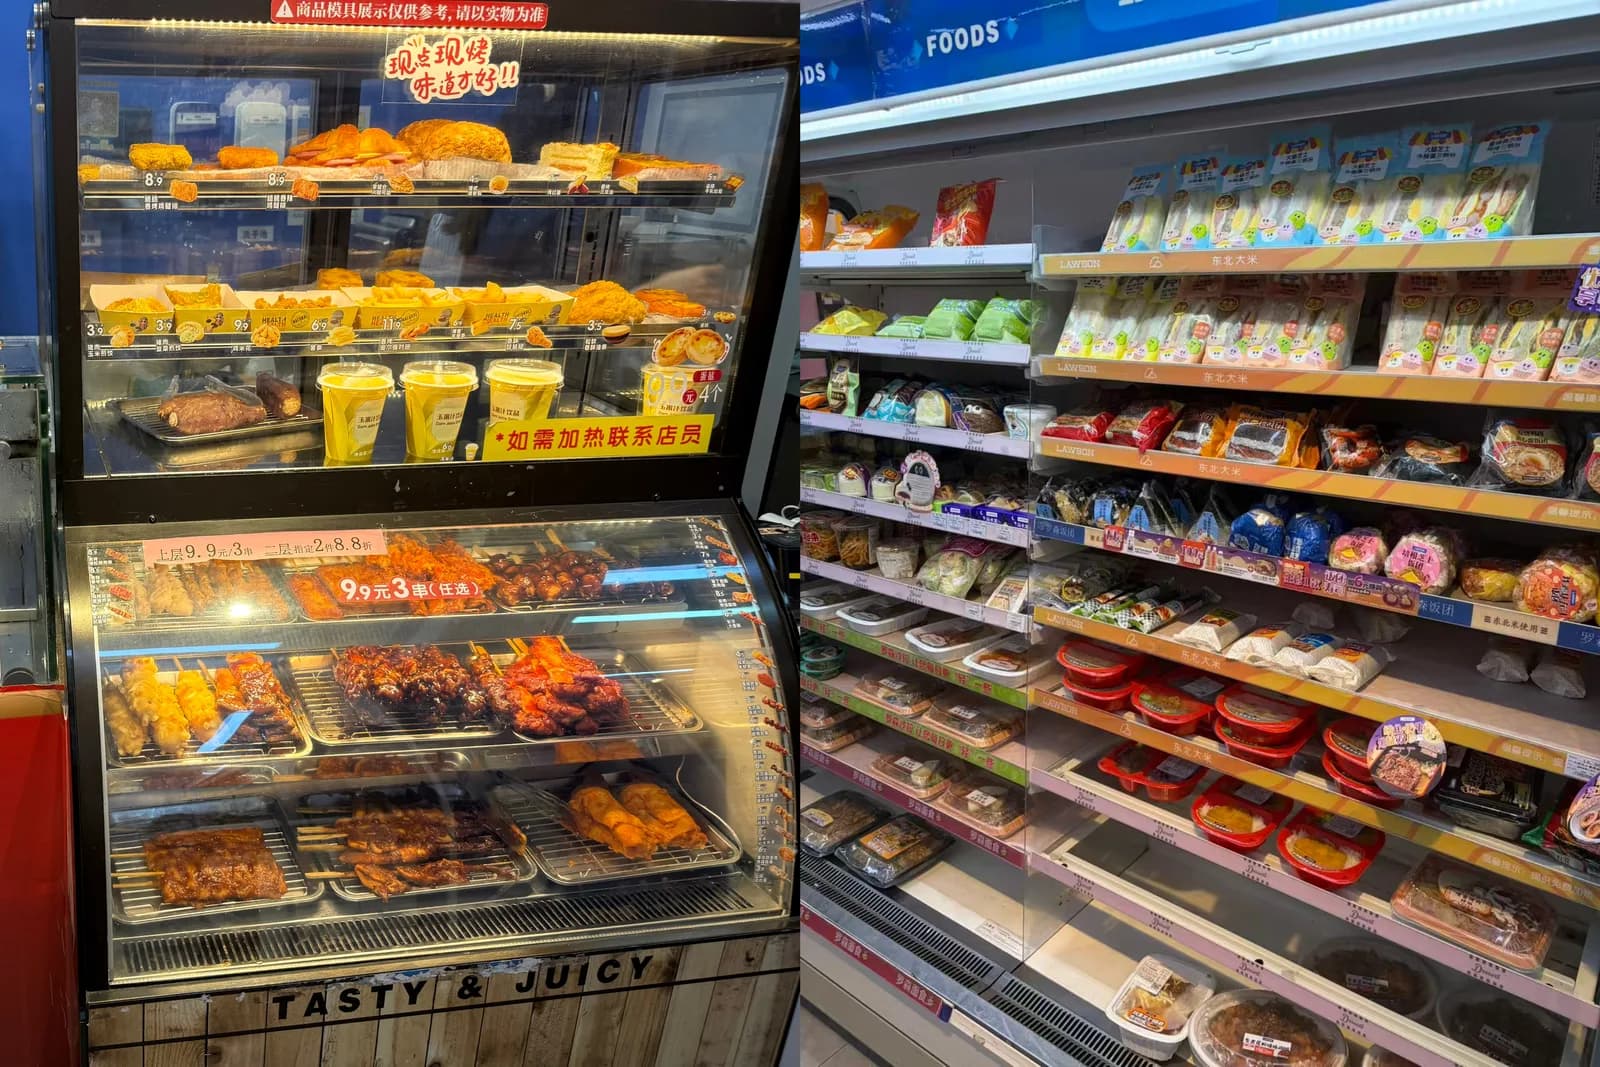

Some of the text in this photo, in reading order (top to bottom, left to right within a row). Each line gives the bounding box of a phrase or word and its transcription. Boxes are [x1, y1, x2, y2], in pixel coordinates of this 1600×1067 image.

[926, 20, 1000, 57] FOODS
[389, 37, 489, 75] 现点现烤
[413, 65, 518, 99] 味道才好!!
[800, 62, 826, 87] DS
[1060, 259, 1101, 269] LAWSON
[1211, 255, 1257, 266] 东北大米
[1057, 363, 1097, 373] LAWSON
[1204, 371, 1248, 384] 东北大米
[1056, 444, 1095, 457] LAWSON
[1199, 463, 1241, 476] 东北大米
[340, 577, 479, 600] 9.9元3串(任选)
[272, 955, 653, 1020] TASTY & JUICY
